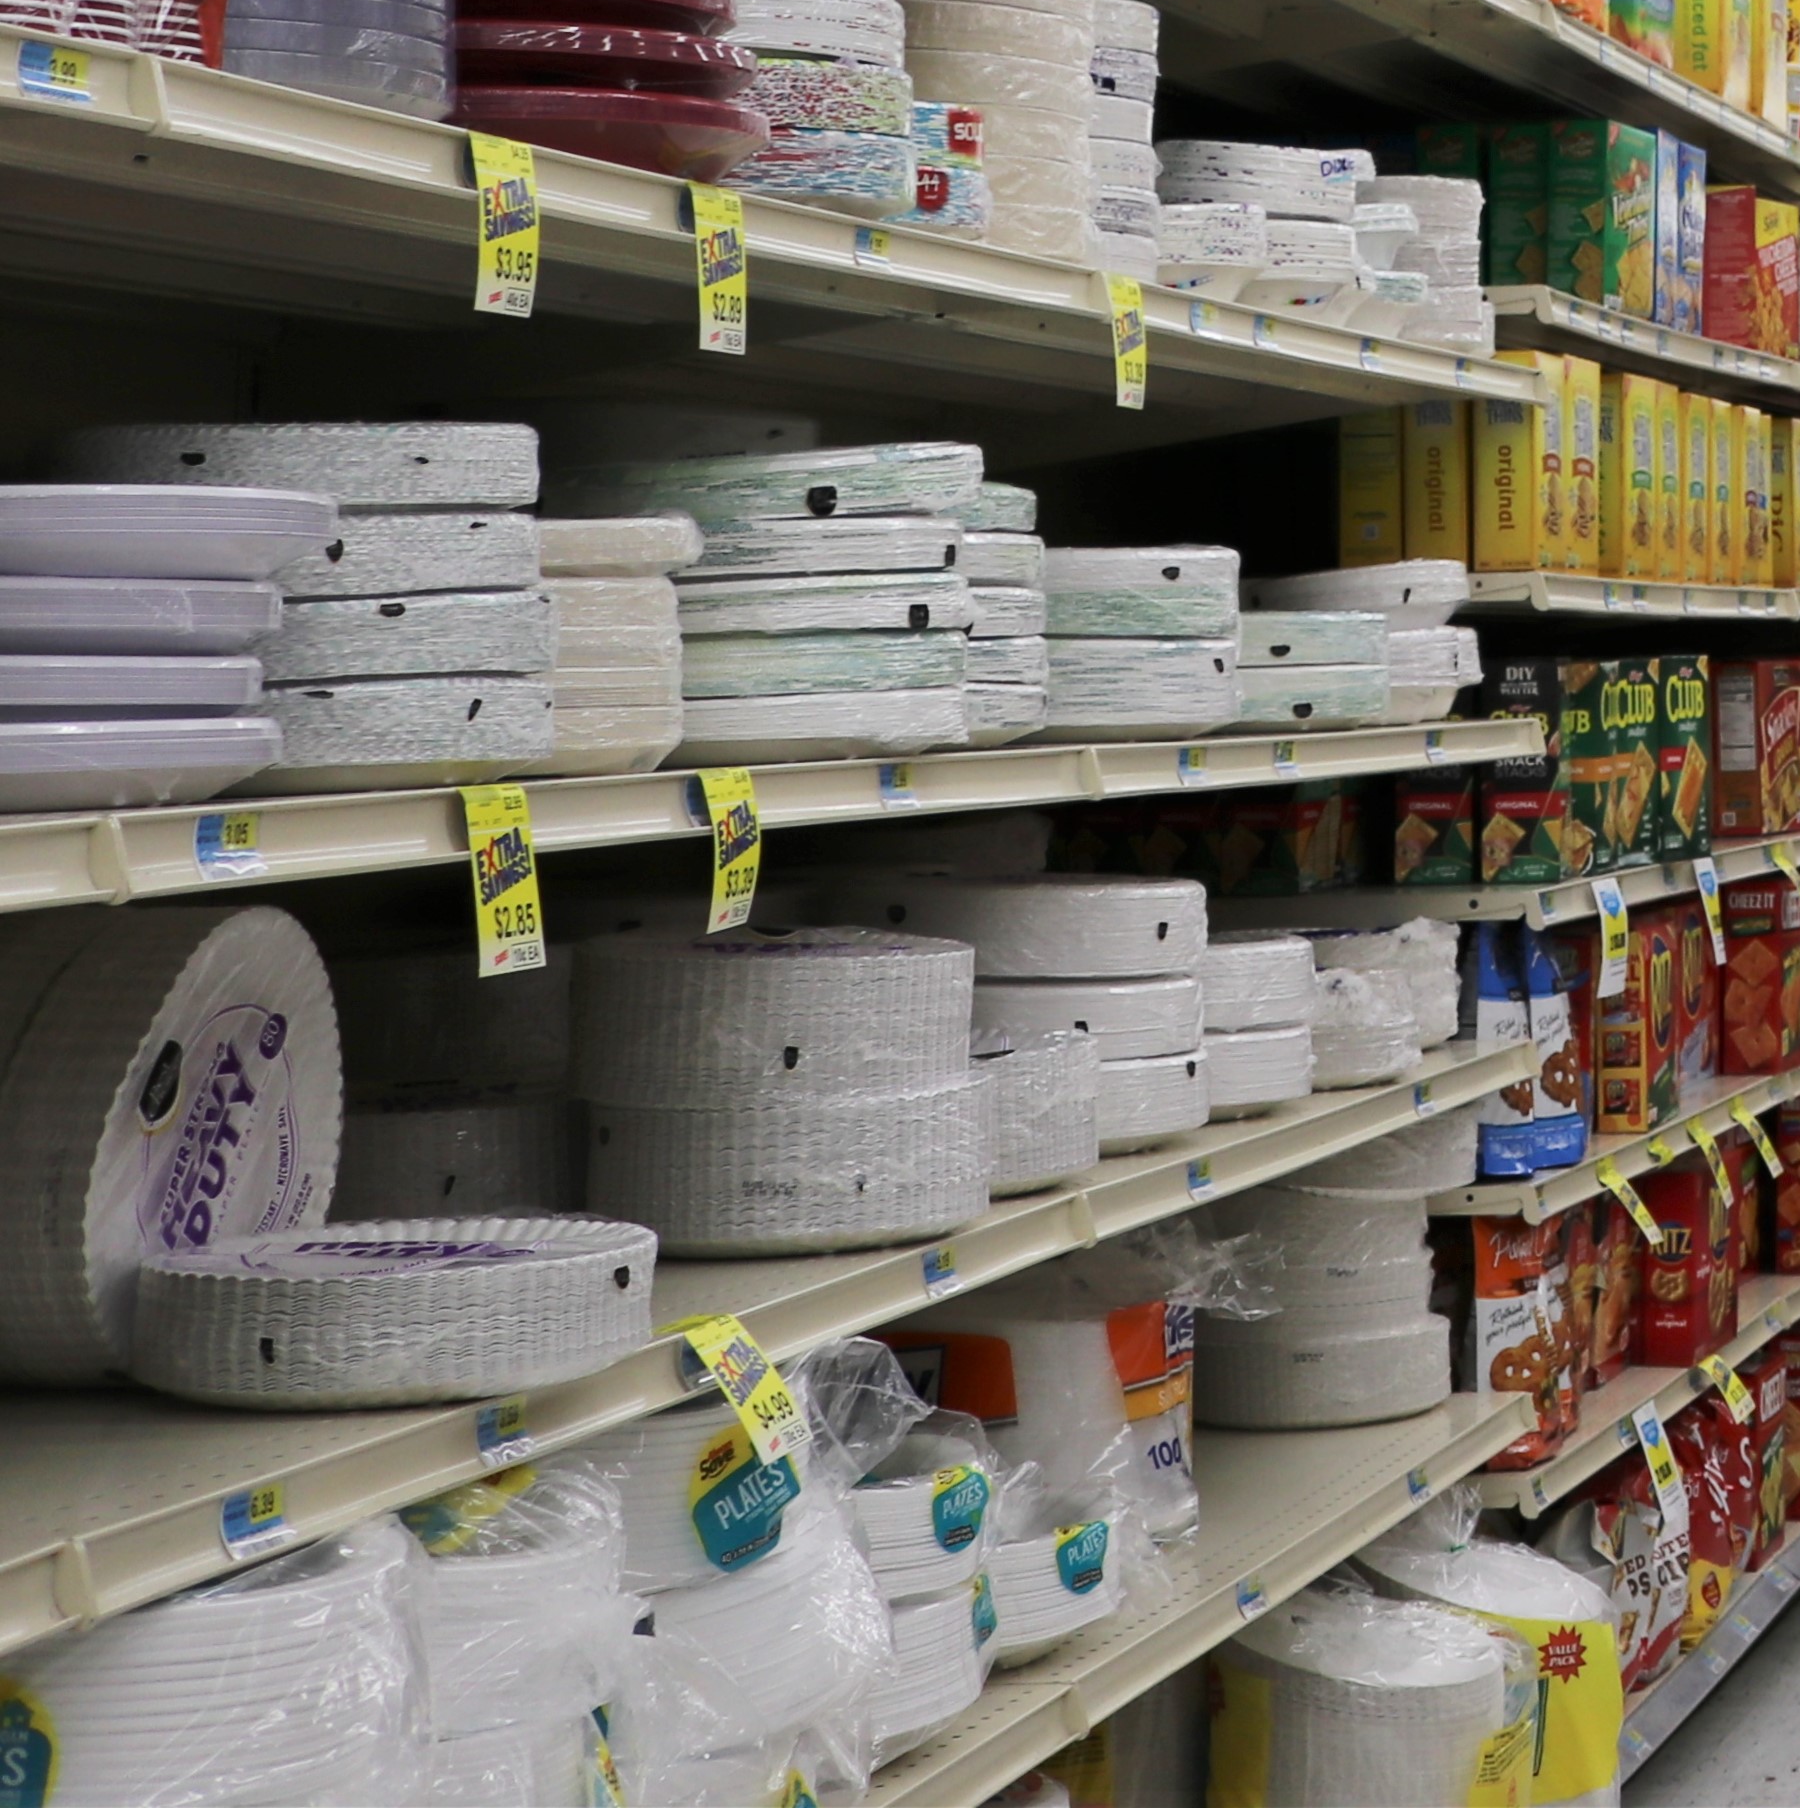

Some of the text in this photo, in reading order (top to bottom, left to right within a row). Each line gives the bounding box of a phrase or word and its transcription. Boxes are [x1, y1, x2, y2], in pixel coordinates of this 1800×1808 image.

[1693, 43, 1706, 71] fat
[482, 177, 530, 218] EXTRA
[496, 247, 532, 283] $3.95
[700, 227, 737, 266] EXTRA
[714, 292, 742, 324] $2.89
[1427, 446, 1444, 532] original
[1497, 444, 1516, 531] original
[1506, 666, 1535, 681] DIY
[1611, 679, 1655, 728] CLUB
[1666, 676, 1704, 723] CLUB
[719, 800, 754, 847] EXTRA
[1495, 800, 1538, 811] ORIGINAL
[476, 827, 528, 882] EXTRA
[495, 903, 535, 940] $2.85
[1728, 895, 1761, 909] CHEEZ
[183, 1076, 255, 1246] DUTY
[277, 1134, 289, 1186] MICROWAVE
[713, 1336, 752, 1384] EXTRA
[753, 1391, 793, 1429] $4.99
[1147, 1439, 1182, 1470] 100
[714, 1458, 786, 1531] PLATES
[943, 1480, 983, 1519] PLATES
[1068, 1523, 1105, 1566] PLATES
[1545, 1642, 1584, 1659] VALUE
[1551, 1654, 1580, 1669] PACK
